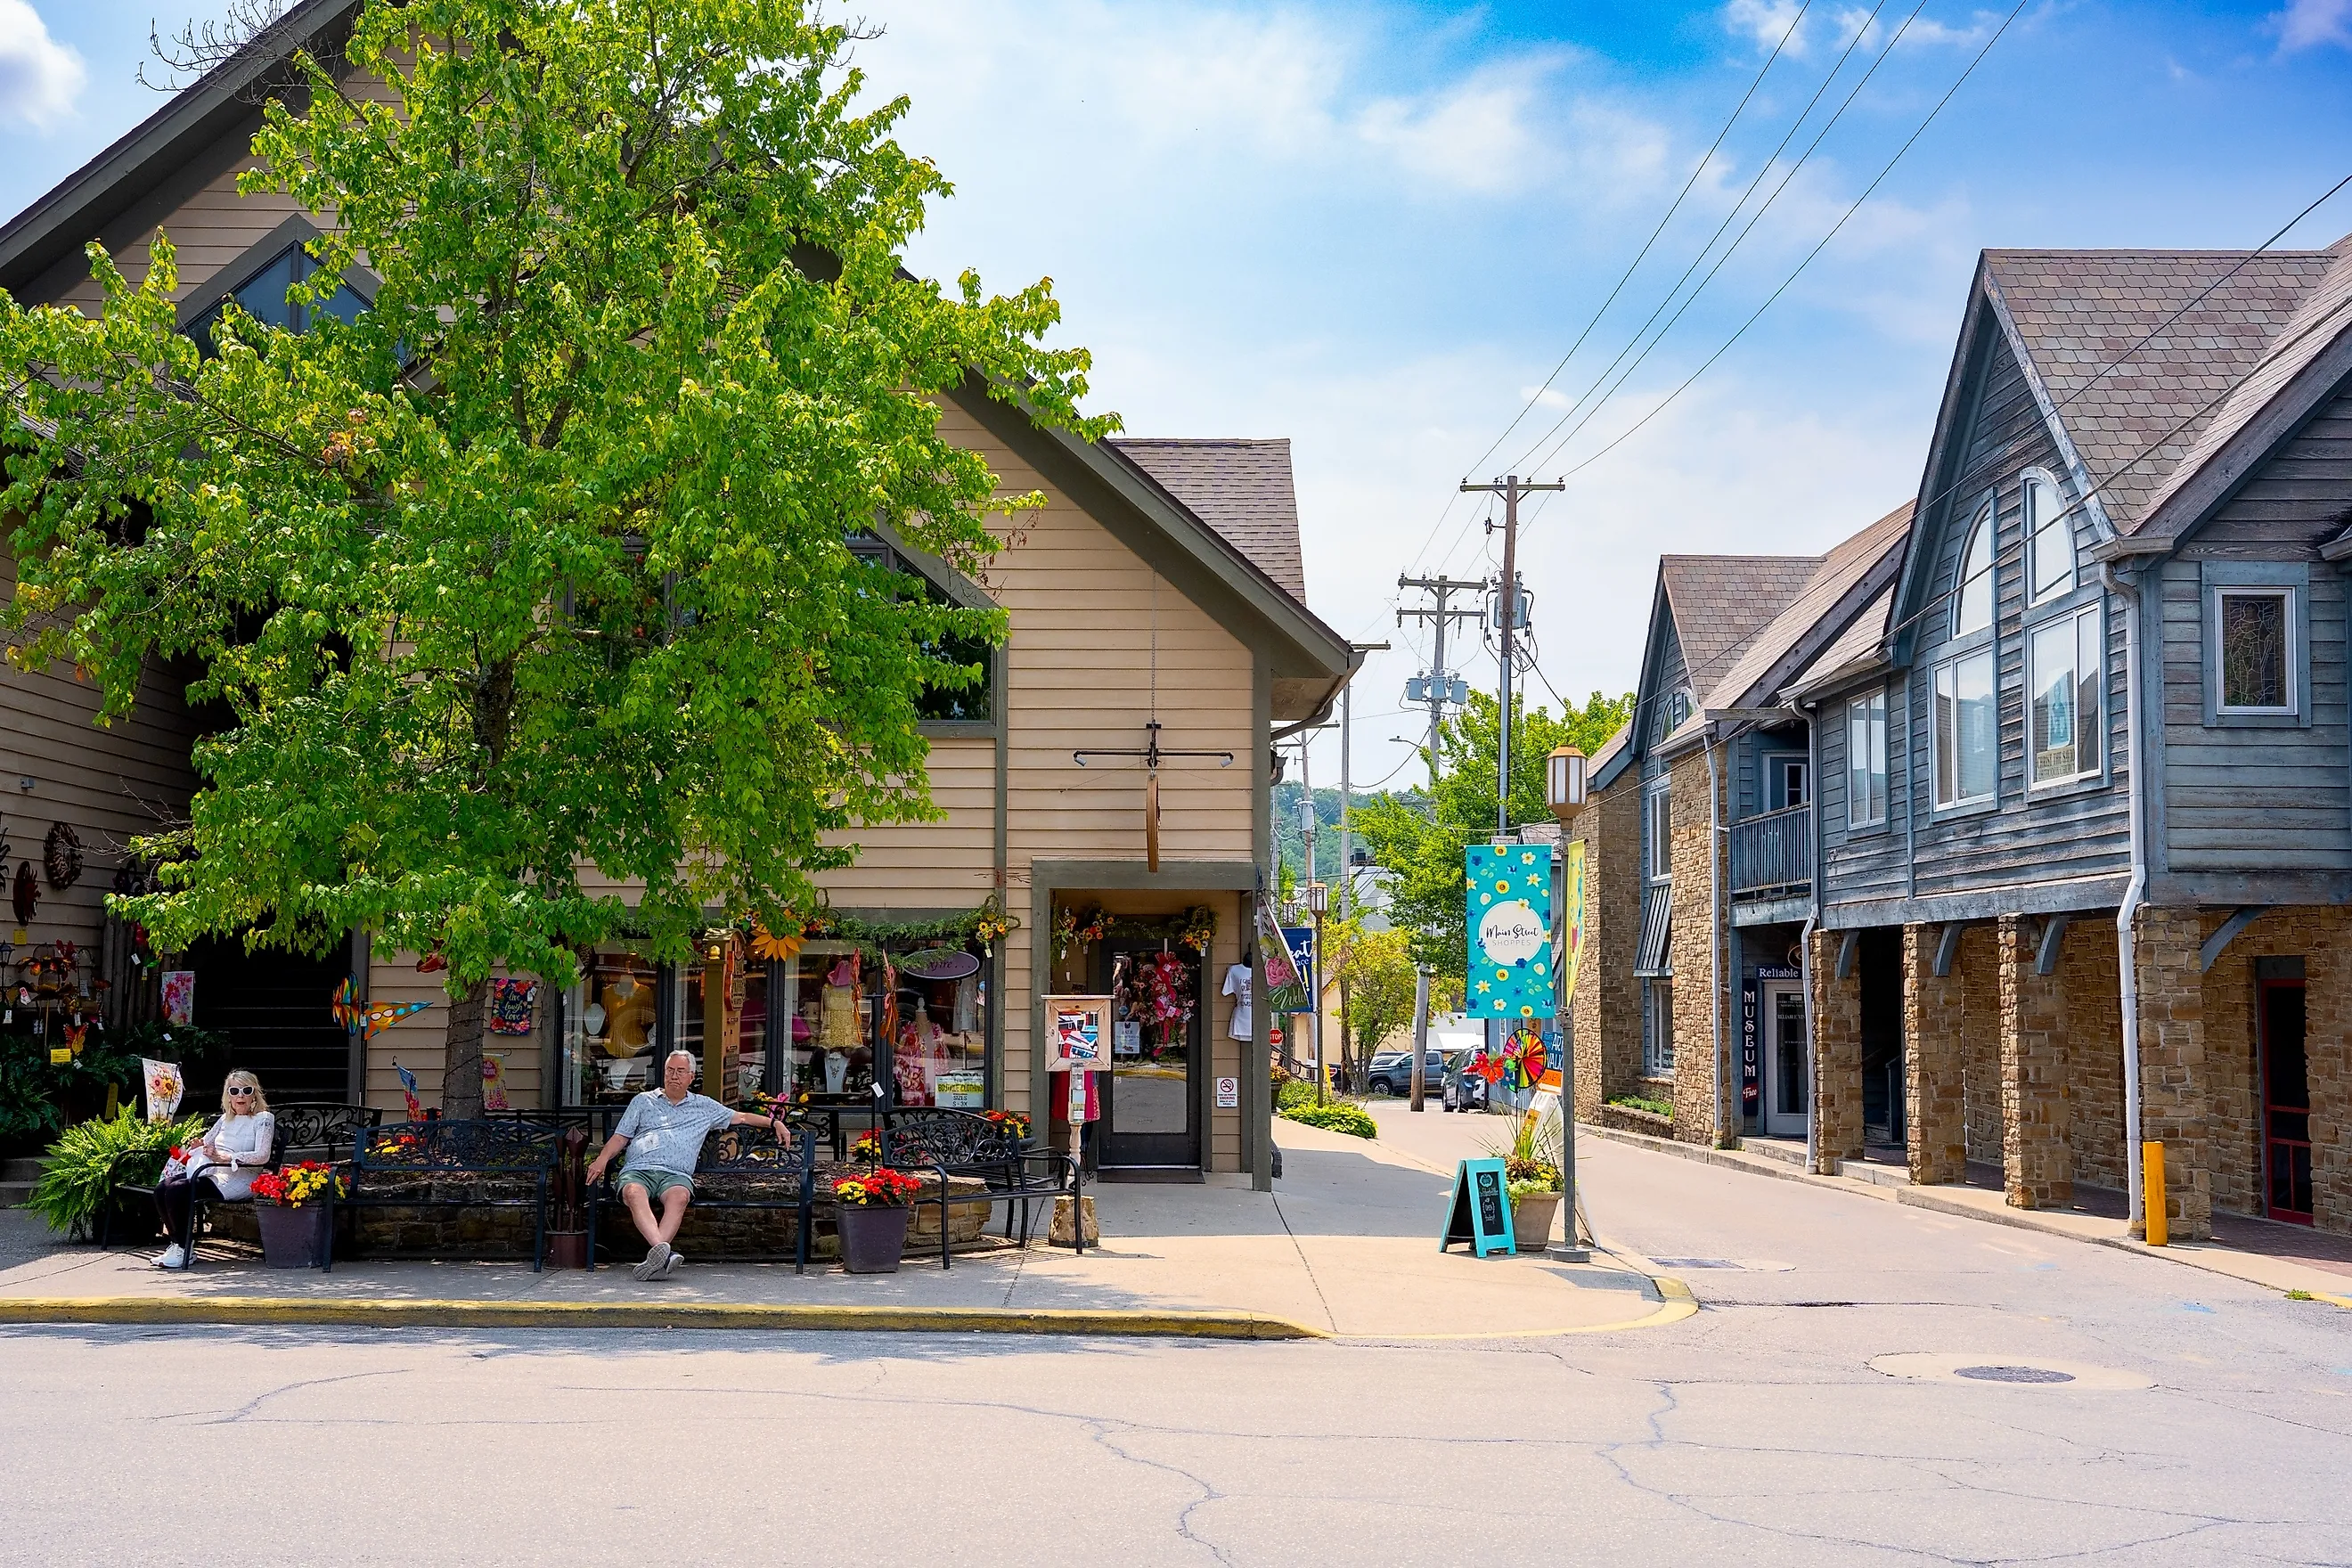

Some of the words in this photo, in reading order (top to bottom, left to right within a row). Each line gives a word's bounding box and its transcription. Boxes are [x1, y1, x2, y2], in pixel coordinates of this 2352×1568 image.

[1486, 924, 1511, 939] Main
[1513, 924, 1539, 939] Street
[1758, 968, 1799, 978] Reliable
[504, 1000, 524, 1014] laugh
[505, 1009, 521, 1020] love
[1744, 991, 1756, 1077] MUSEUM
[1743, 1087, 1758, 1099] Free
